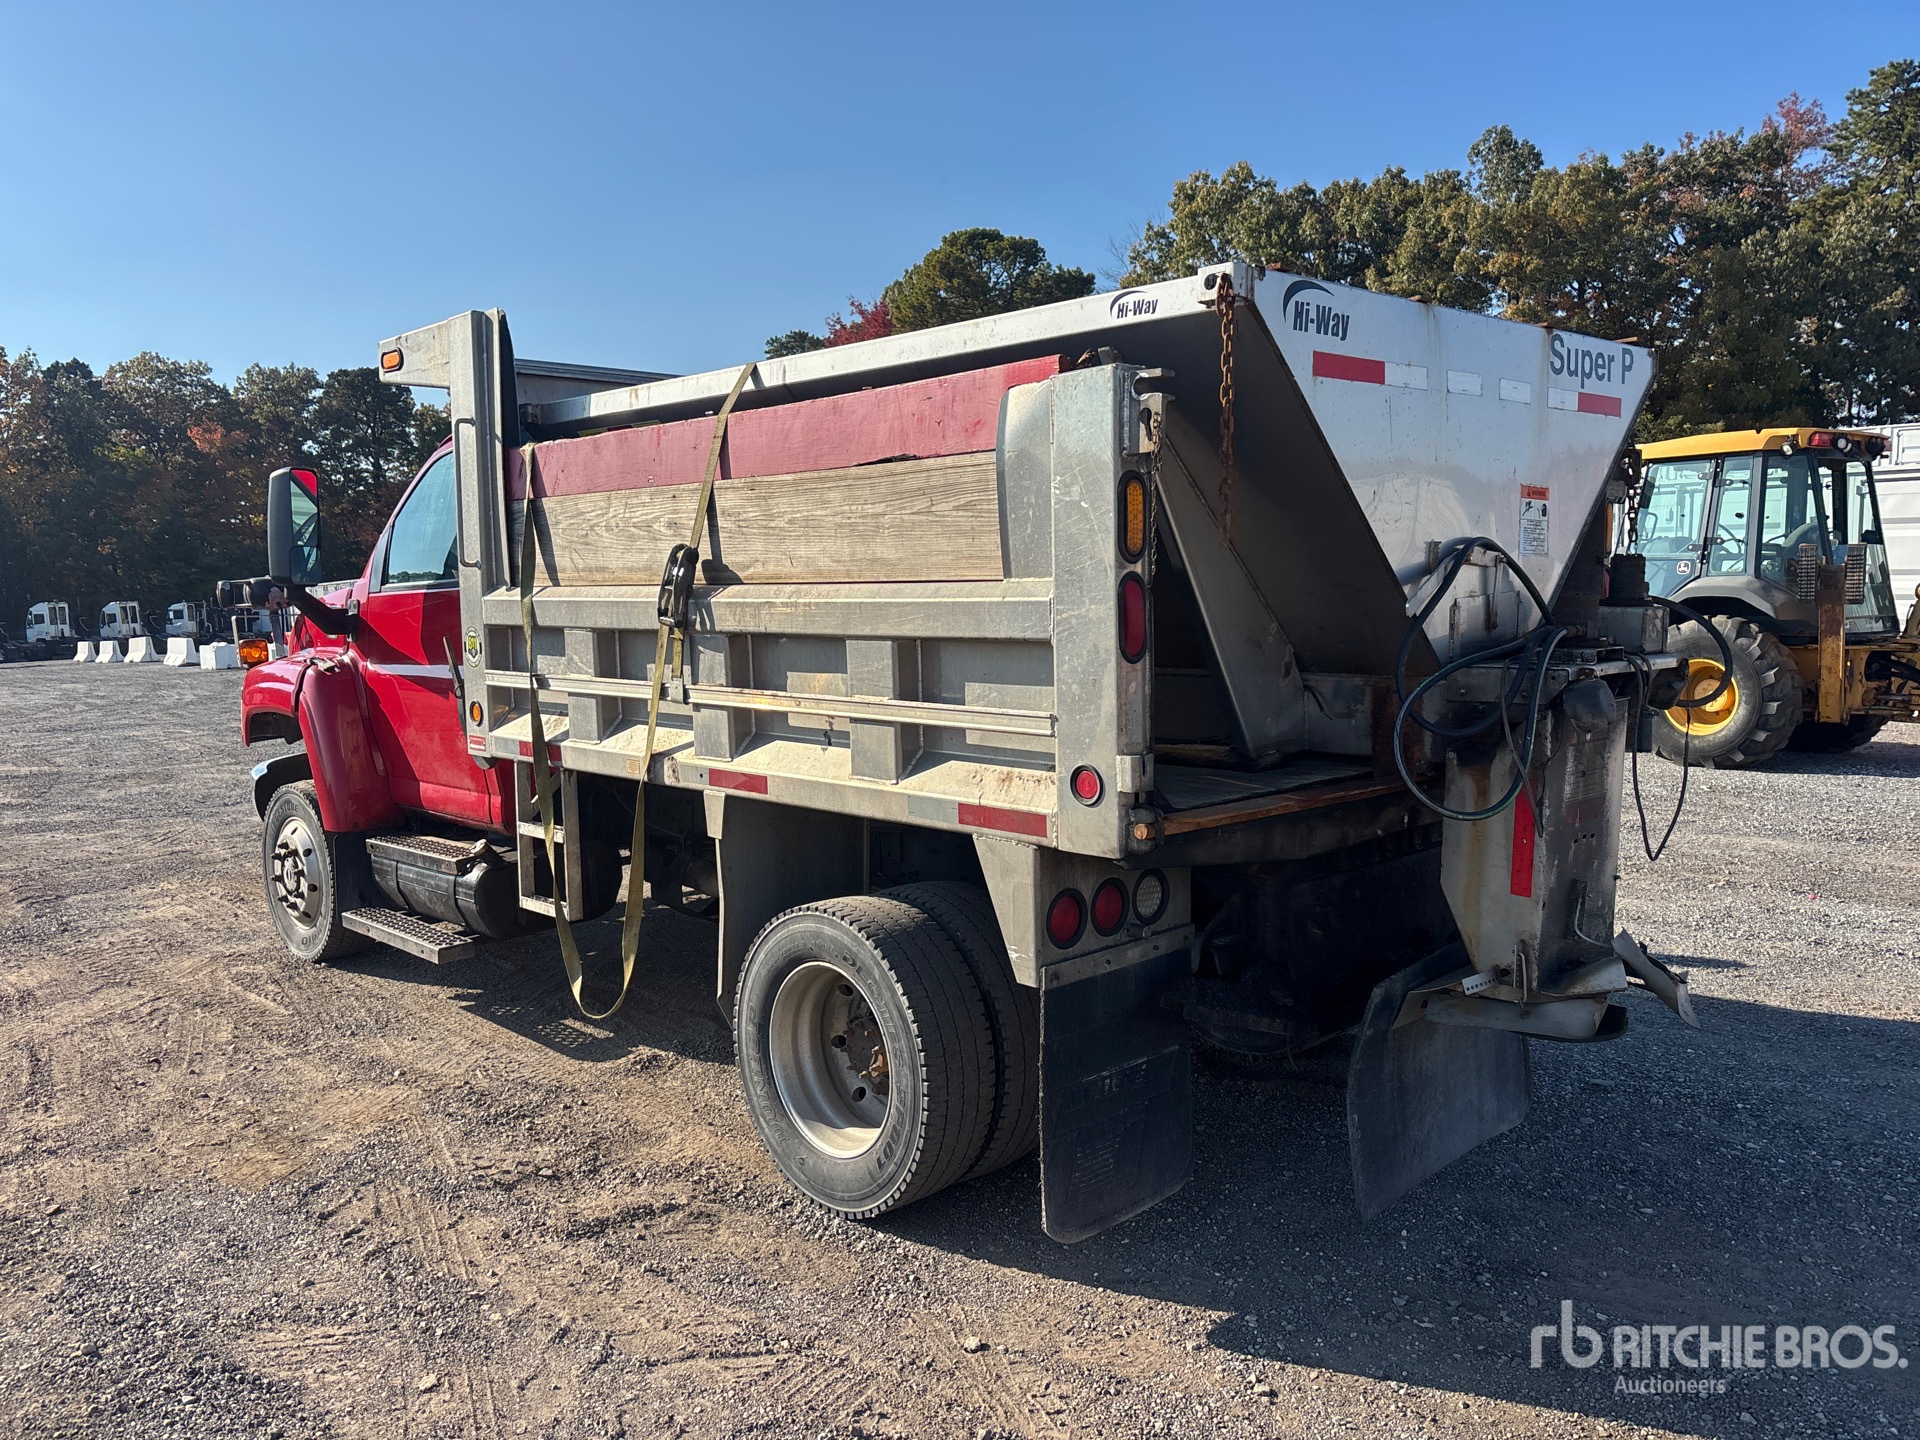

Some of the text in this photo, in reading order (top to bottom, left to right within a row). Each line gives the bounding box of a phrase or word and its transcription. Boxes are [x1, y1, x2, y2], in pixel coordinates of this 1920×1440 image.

[1116, 299, 1158, 319] Hi-Way
[1292, 300, 1350, 341] Hi-Way
[1549, 333, 1634, 389] Super P
